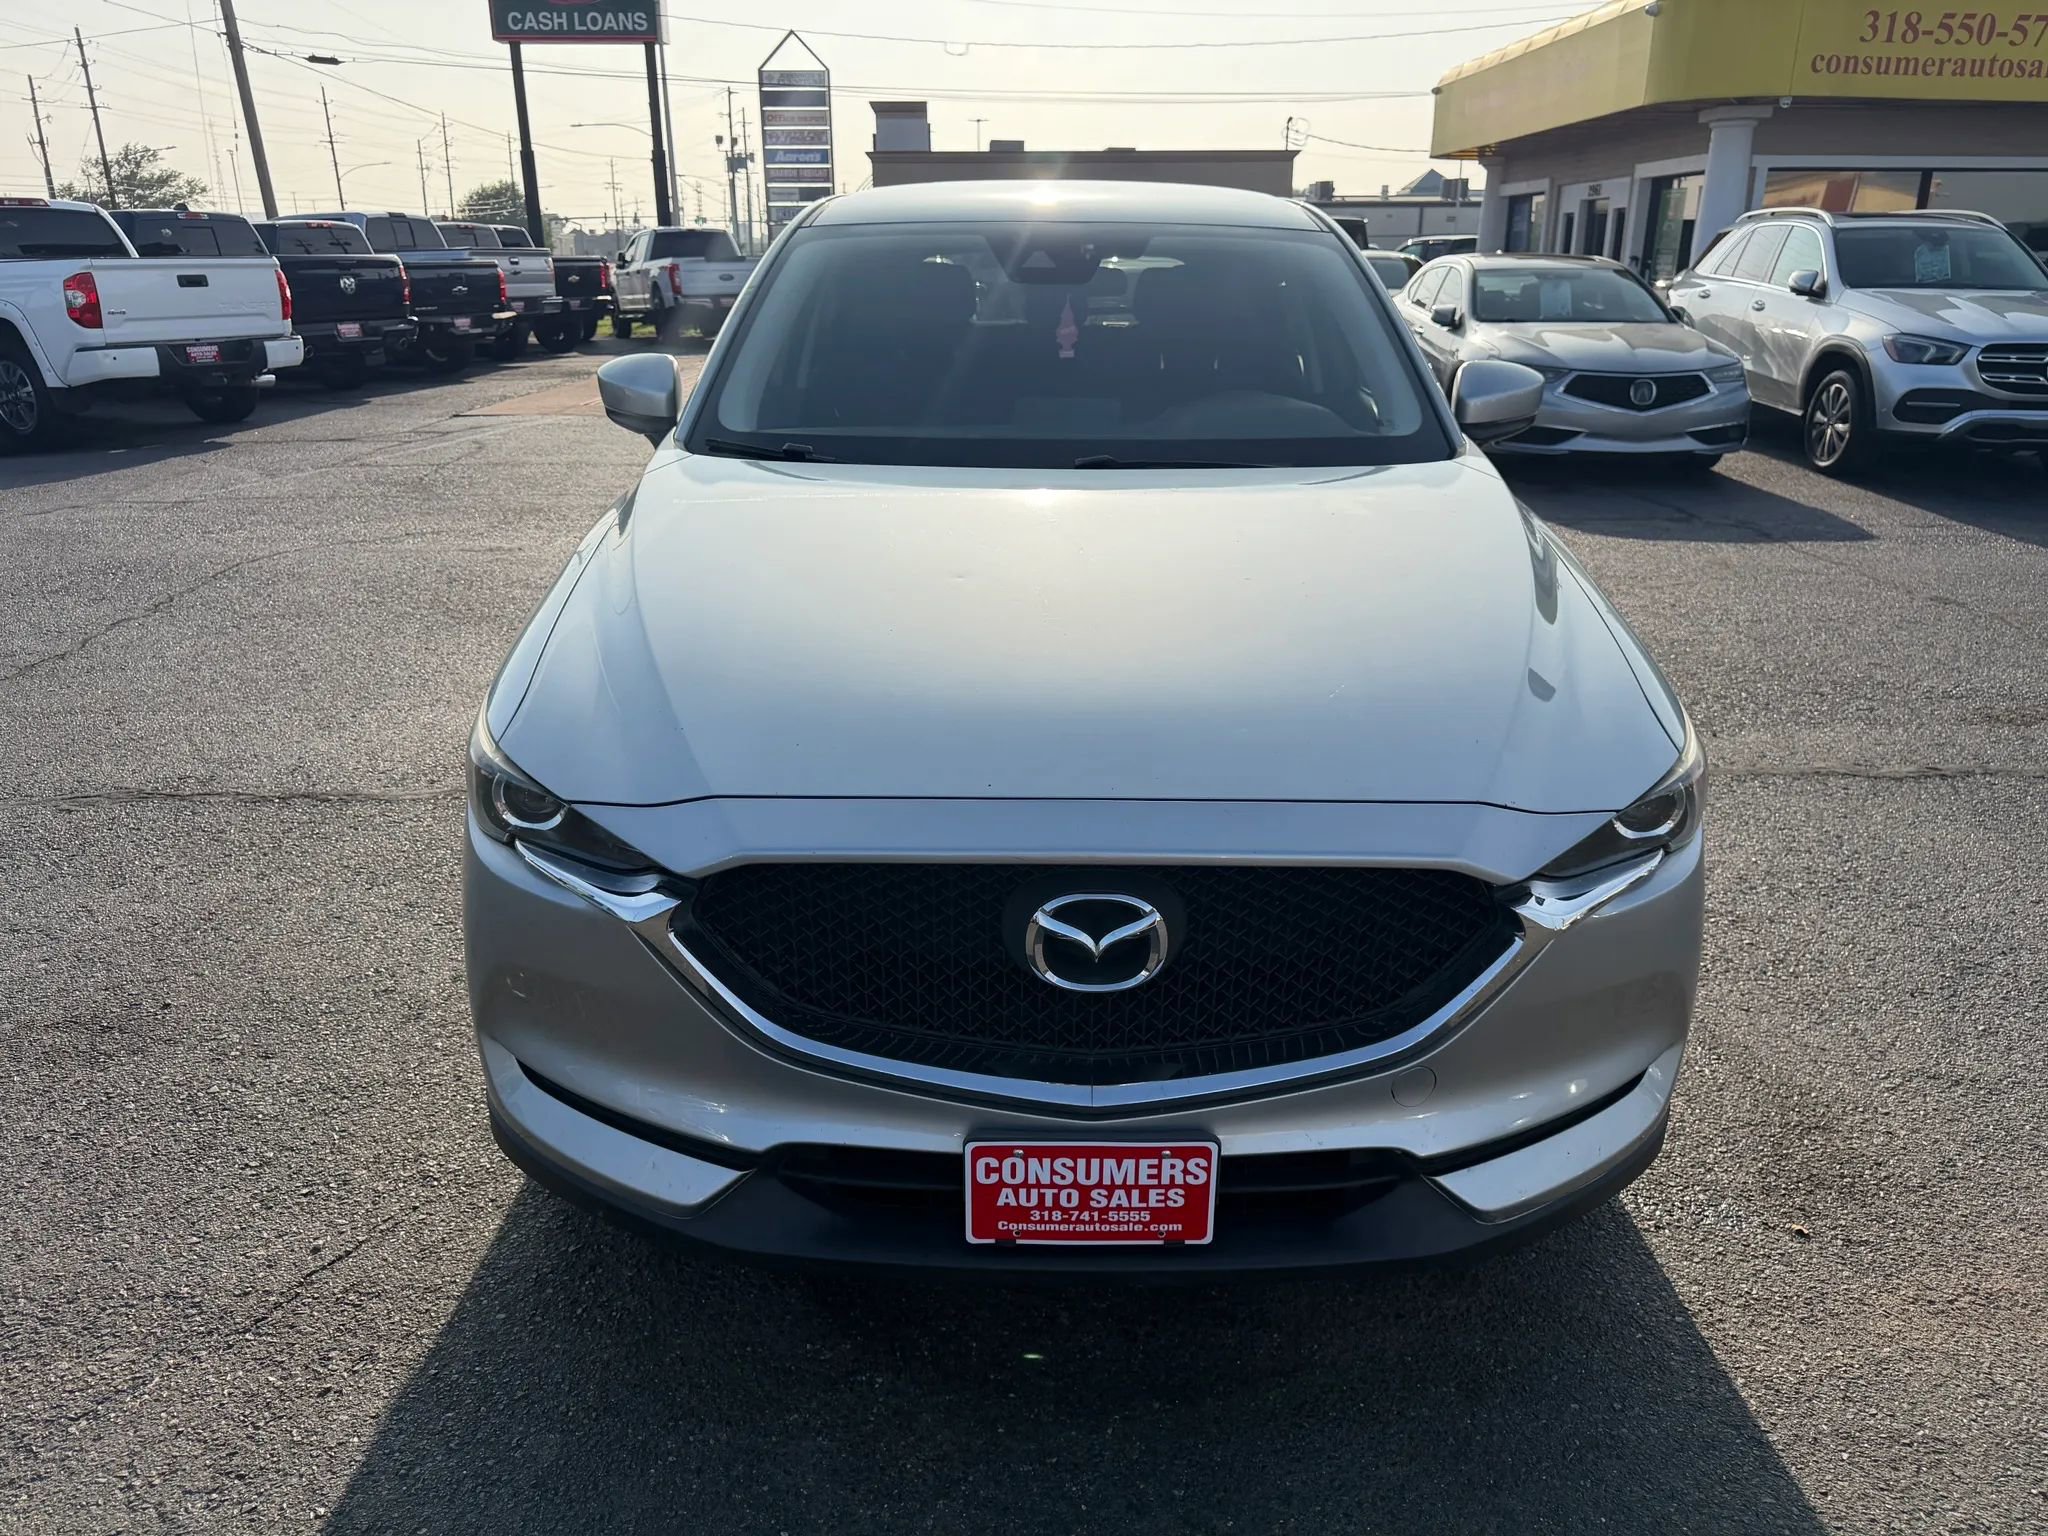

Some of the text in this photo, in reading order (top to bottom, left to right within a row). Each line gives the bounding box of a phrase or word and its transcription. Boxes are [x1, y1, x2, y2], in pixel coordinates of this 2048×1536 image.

[508, 12, 648, 31] CASH LOANS
[976, 1157, 1208, 1185] CONSUMERS
[996, 1188, 1185, 1208] AUTO SALES
[1030, 1210, 1151, 1222] 318-741-5555
[997, 1221, 1182, 1232] Consumerautosale.com
